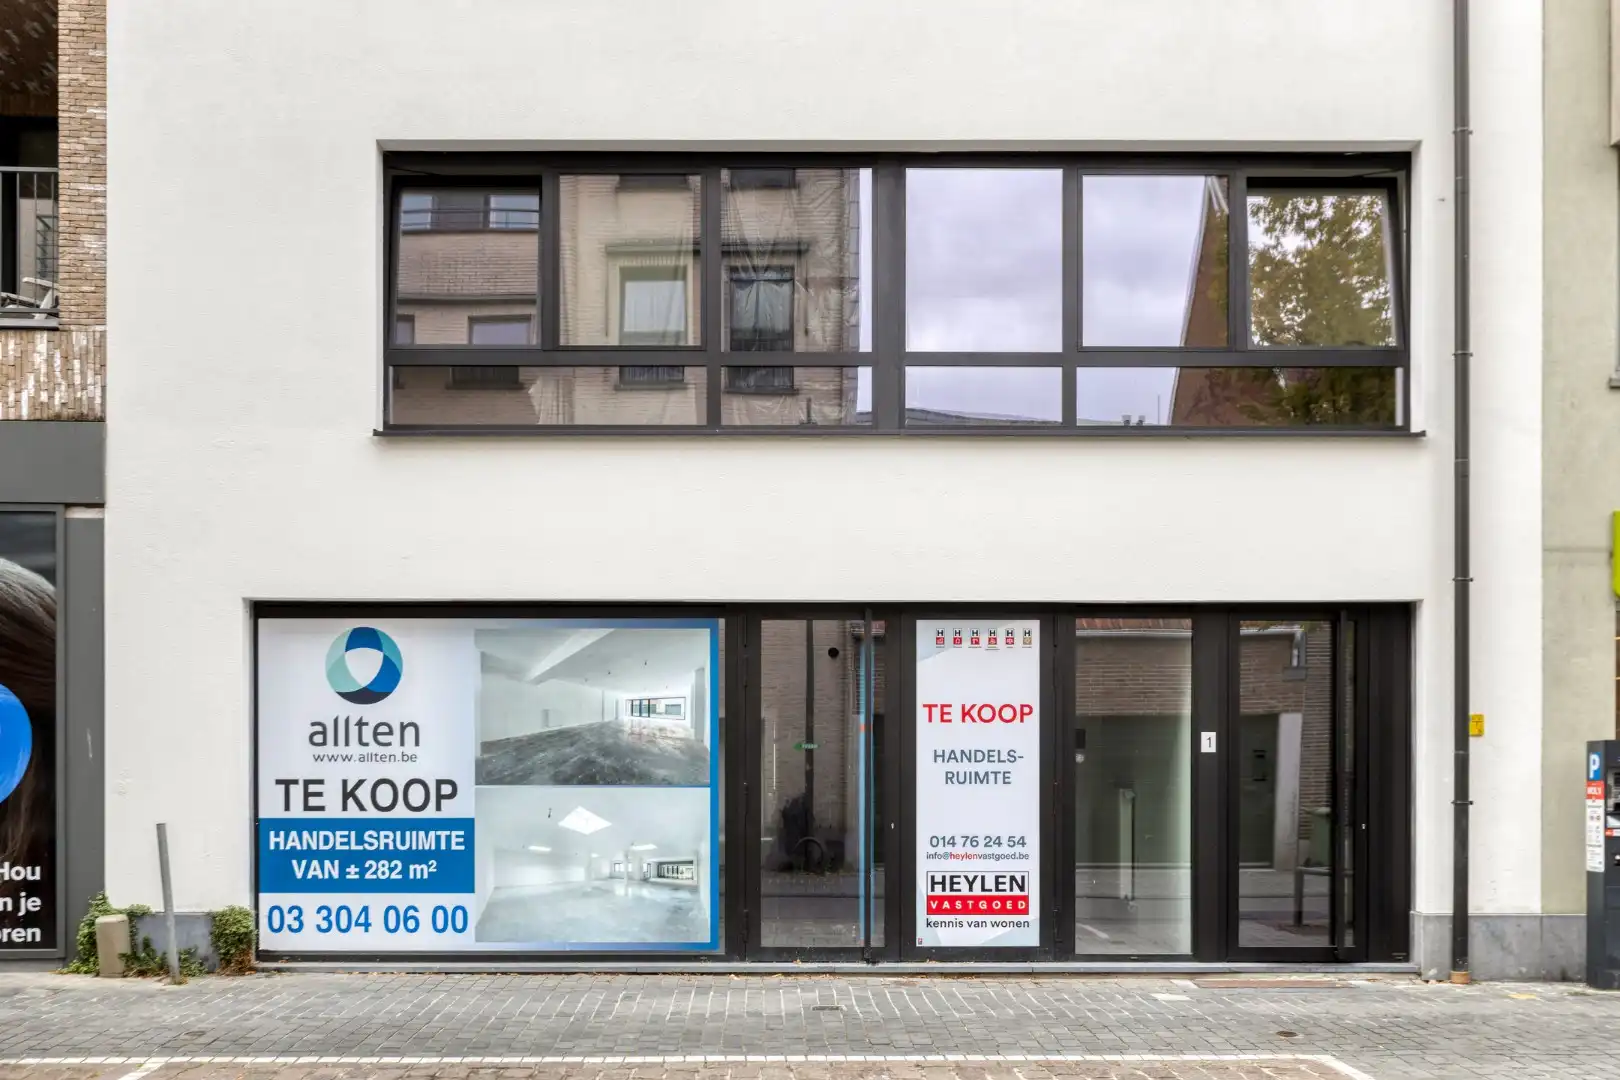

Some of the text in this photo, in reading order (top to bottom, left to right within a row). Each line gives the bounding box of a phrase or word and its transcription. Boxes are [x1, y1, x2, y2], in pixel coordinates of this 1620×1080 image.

[937, 629, 1031, 637] H H H H H H
[923, 704, 1033, 723] TE KOOP
[308, 715, 420, 748] allten
[1206, 736, 1212, 748] 1
[313, 751, 418, 763] www.allten.be
[933, 749, 1023, 763] HANDELS-
[1589, 754, 1600, 779] P
[945, 771, 1011, 784] RUIMTE
[275, 778, 458, 813] TE KOOP
[269, 830, 465, 850] HANDELSRUIMTE
[930, 836, 1026, 848] 014 76 24 54
[927, 852, 1029, 861] info@heylenvastgoed.be
[291, 860, 340, 879] VAN
[365, 860, 402, 879] 282
[930, 875, 1025, 892] HEYLEN
[17, 892, 41, 916] je
[930, 900, 1026, 910] VASTGOED
[267, 904, 468, 934] 03 304 06 00
[926, 918, 1029, 928] kennis van wonen
[0, 928, 41, 942] ren
